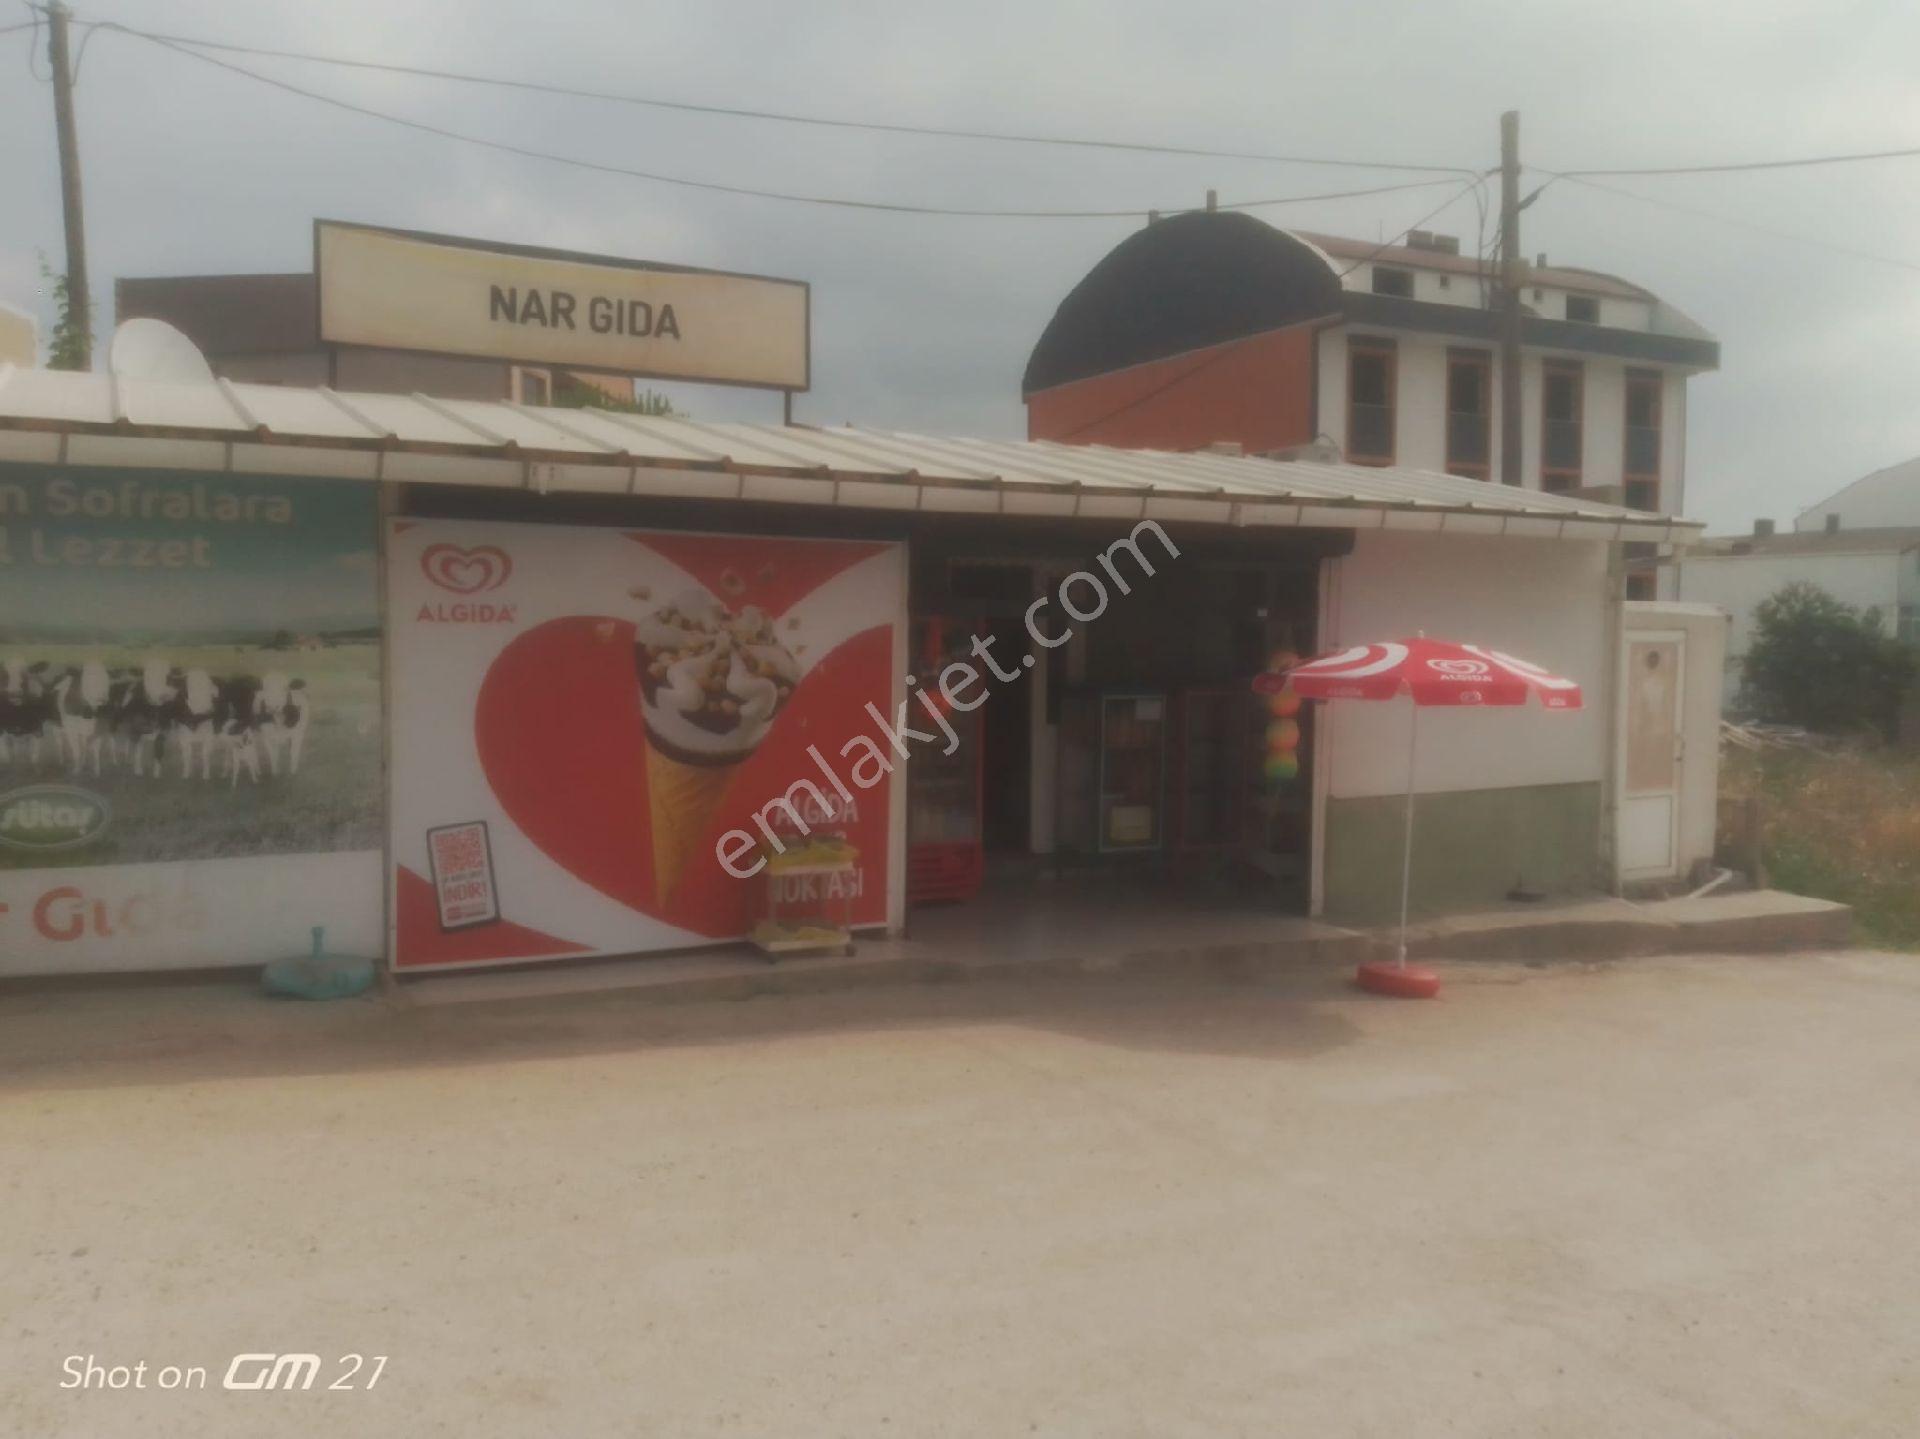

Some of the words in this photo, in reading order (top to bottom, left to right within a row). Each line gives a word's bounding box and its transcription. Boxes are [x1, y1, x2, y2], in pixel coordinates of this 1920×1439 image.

[489, 284, 576, 331] NAR
[590, 296, 682, 341] GIDA
[46, 479, 294, 525] Sofralara
[31, 527, 216, 569] Lezzet
